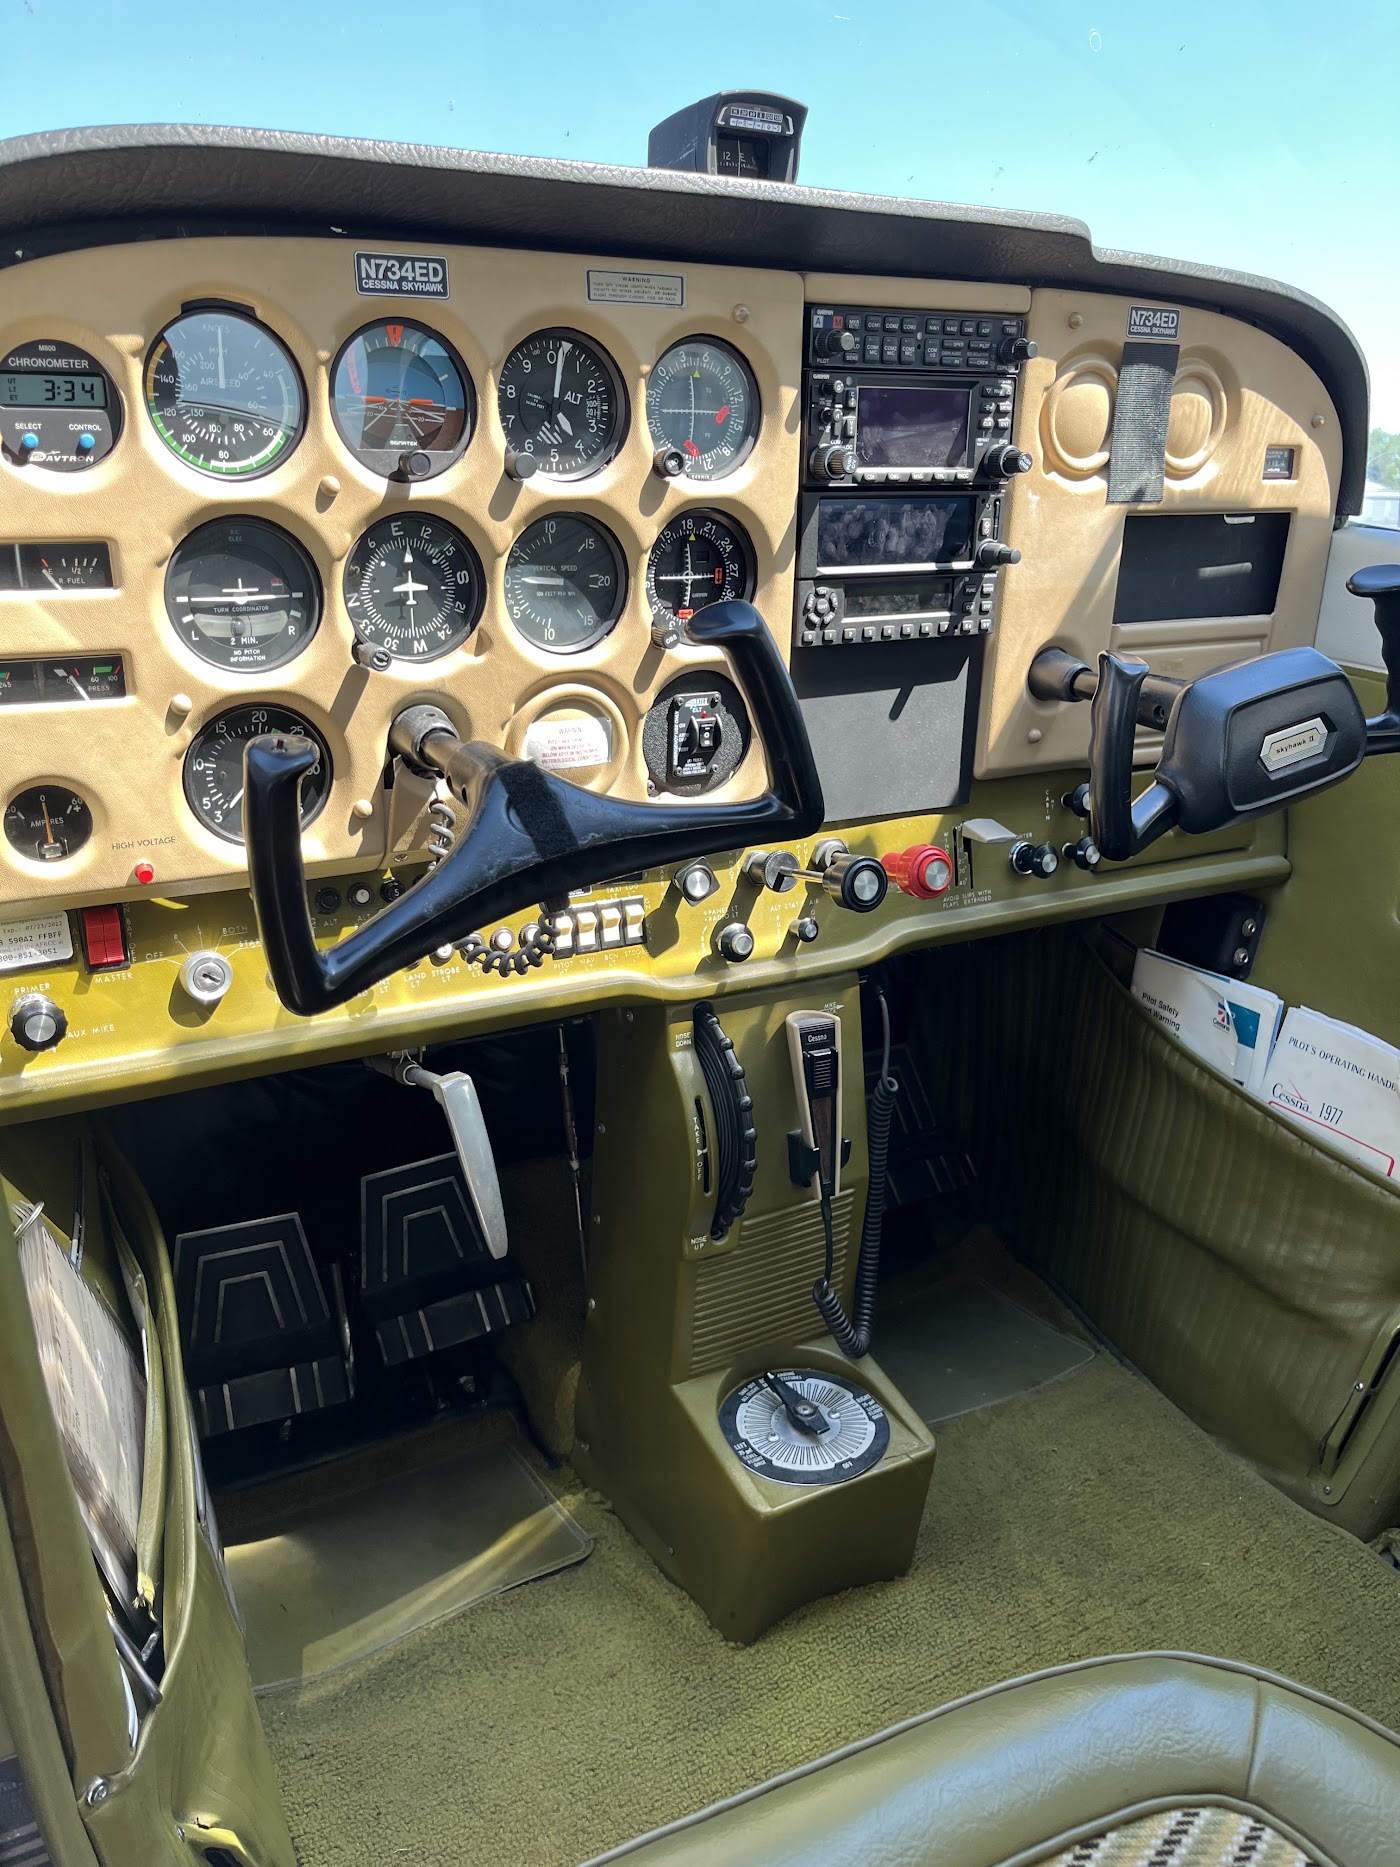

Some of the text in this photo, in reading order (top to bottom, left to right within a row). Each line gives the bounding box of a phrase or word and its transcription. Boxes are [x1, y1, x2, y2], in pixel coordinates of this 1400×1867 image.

[722, 151, 731, 161] 12
[360, 258, 443, 282] N734ED
[622, 276, 651, 284] WARNING
[362, 279, 444, 293] CESSNA SKYHAWK
[1131, 310, 1177, 328] N734ED
[1152, 327, 1176, 335] SKYHAWK
[546, 350, 557, 365] 0
[679, 351, 687, 362] 3
[702, 352, 710, 362] 6
[8, 357, 90, 369] CHRONOMETER
[200, 361, 215, 370] 200
[522, 359, 532, 374] 9
[238, 372, 249, 380] 40
[263, 370, 274, 379] 40
[657, 366, 667, 377] 0
[723, 366, 732, 376] 9
[160, 374, 175, 384] 140
[200, 377, 241, 388] AIRSEED
[43, 379, 95, 402] 3:34
[184, 383, 199, 391] 160
[506, 384, 516, 399] 8
[587, 379, 597, 394] 2
[563, 390, 583, 405] ALT
[733, 389, 744, 403] 12
[247, 401, 259, 409] 60
[163, 408, 177, 417] 120
[505, 414, 516, 429] 7
[588, 419, 597, 433] 3
[734, 419, 744, 432] 15
[208, 424, 222, 433] 100
[233, 423, 245, 432] 80
[263, 428, 274, 436] 60
[182, 434, 196, 443] 100
[524, 439, 534, 453] 6
[574, 439, 584, 452] 4
[722, 443, 735, 457] 18
[218, 451, 229, 459] 80
[550, 448, 559, 462] 5
[390, 521, 404, 536] E
[545, 521, 556, 533] 10
[681, 518, 693, 530] 18
[703, 522, 717, 535] 21
[420, 526, 433, 539] 12
[660, 529, 671, 542] 15
[367, 538, 376, 548] 6
[585, 538, 595, 549] 15
[720, 537, 734, 553] 24
[444, 543, 456, 556] 15
[513, 544, 520, 556] 5
[730, 563, 739, 577] 27
[456, 570, 470, 585] S
[504, 576, 511, 588] 0
[597, 575, 611, 587] 20
[346, 592, 361, 608] N
[232, 605, 269, 613] COORDINATOR
[454, 601, 466, 614] 21
[513, 606, 521, 619] 5
[583, 615, 594, 626] 15
[288, 625, 296, 635] R
[359, 618, 376, 636] 33
[437, 623, 453, 641] 24
[191, 630, 199, 641] L
[544, 629, 555, 640] 10
[665, 634, 678, 645] OBS
[241, 636, 259, 645] MIN.
[383, 637, 400, 651] 30
[230, 655, 266, 663] INFORMATION
[252, 711, 268, 722] 20
[215, 721, 227, 733] 15
[290, 726, 304, 736] 25
[1276, 739, 1306, 754] skyhawk
[193, 759, 204, 771] 10
[39, 794, 46, 802] 0
[71, 797, 83, 805] 60
[202, 797, 211, 809] 5
[214, 811, 223, 822] 3
[111, 836, 176, 850] HIGH VOLTAGE
[394, 889, 400, 897] 5
[607, 886, 622, 894] TAXI
[942, 895, 992, 909] FLAPS EXTENDED
[708, 906, 728, 915] PANEL
[323, 918, 337, 927] ALT
[708, 914, 729, 922] RADIO
[222, 925, 248, 935] BOTH
[8, 935, 34, 945] 590A2
[38, 931, 63, 941] FFBFF
[129, 943, 137, 964] OFF
[145, 952, 164, 960] OFF
[604, 953, 619, 961] BCN
[553, 961, 574, 969] PITOT
[403, 972, 427, 982] LAND
[431, 966, 460, 977] STROBE
[95, 973, 133, 984] MASTER
[411, 980, 420, 988] LT
[14, 982, 51, 995] PRIMER
[380, 986, 389, 994] LT
[1142, 992, 1180, 1018] Pilot Safety
[1153, 1010, 1180, 1031] Warning
[1212, 1017, 1230, 1032] Cessna
[67, 1024, 115, 1038] AUX MIKE
[675, 1032, 692, 1040] NOSE
[675, 1039, 692, 1048] DOWN
[807, 1034, 828, 1043] Cessna
[1288, 1036, 1317, 1056] PILOT'S
[1319, 1050, 1366, 1077] OPERATING
[1271, 1082, 1344, 1125] Cessna 1977
[692, 1116, 701, 1144] TAKE
[690, 1235, 708, 1245] NOSE
[694, 1242, 705, 1251] UP
